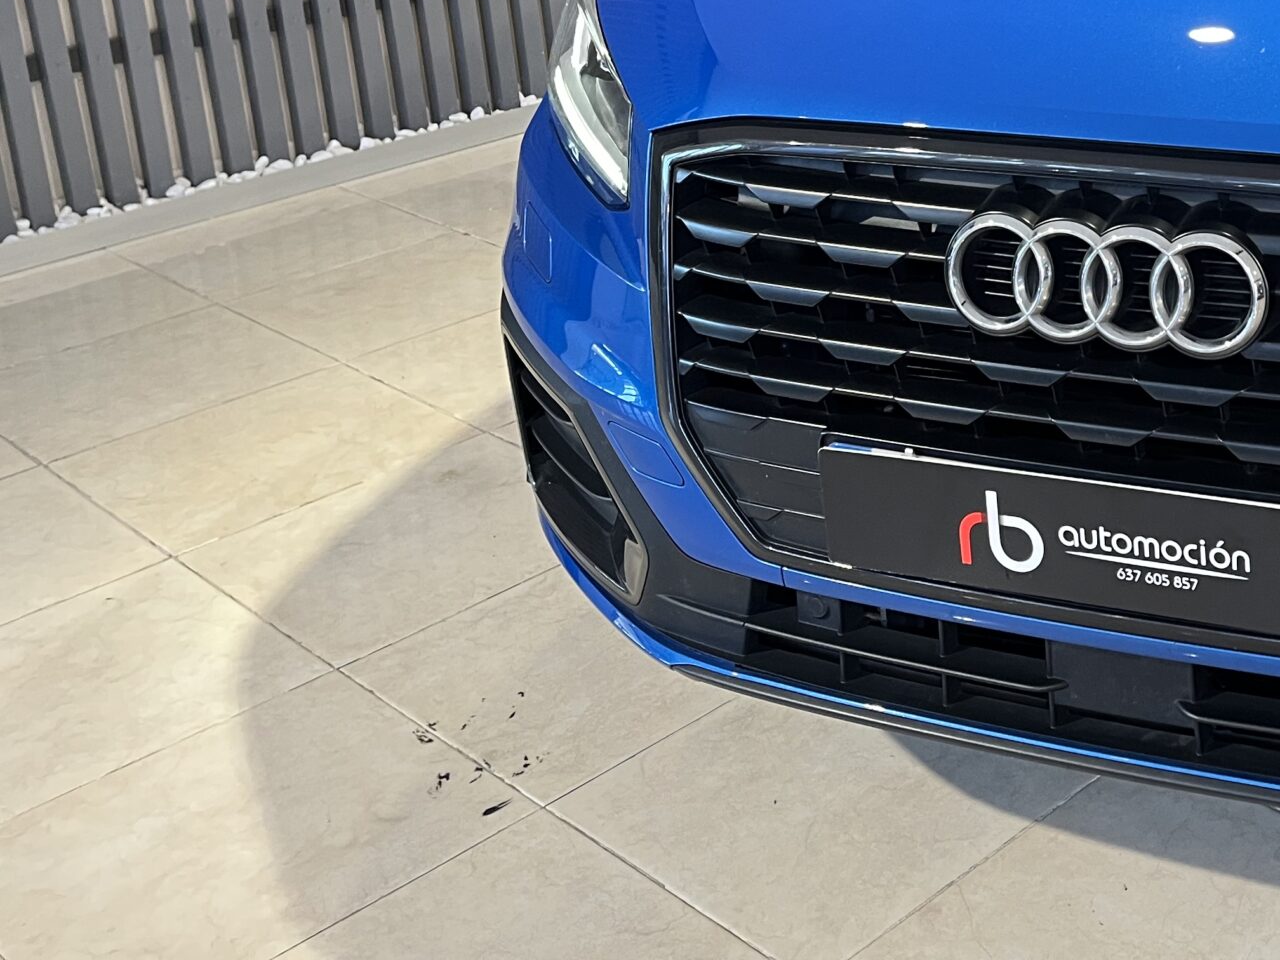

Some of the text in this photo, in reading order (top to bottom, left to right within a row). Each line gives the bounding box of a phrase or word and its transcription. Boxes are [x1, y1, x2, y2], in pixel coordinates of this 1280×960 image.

[959, 490, 1251, 573] rb automoción
[1116, 567, 1199, 591] 637 605 857
